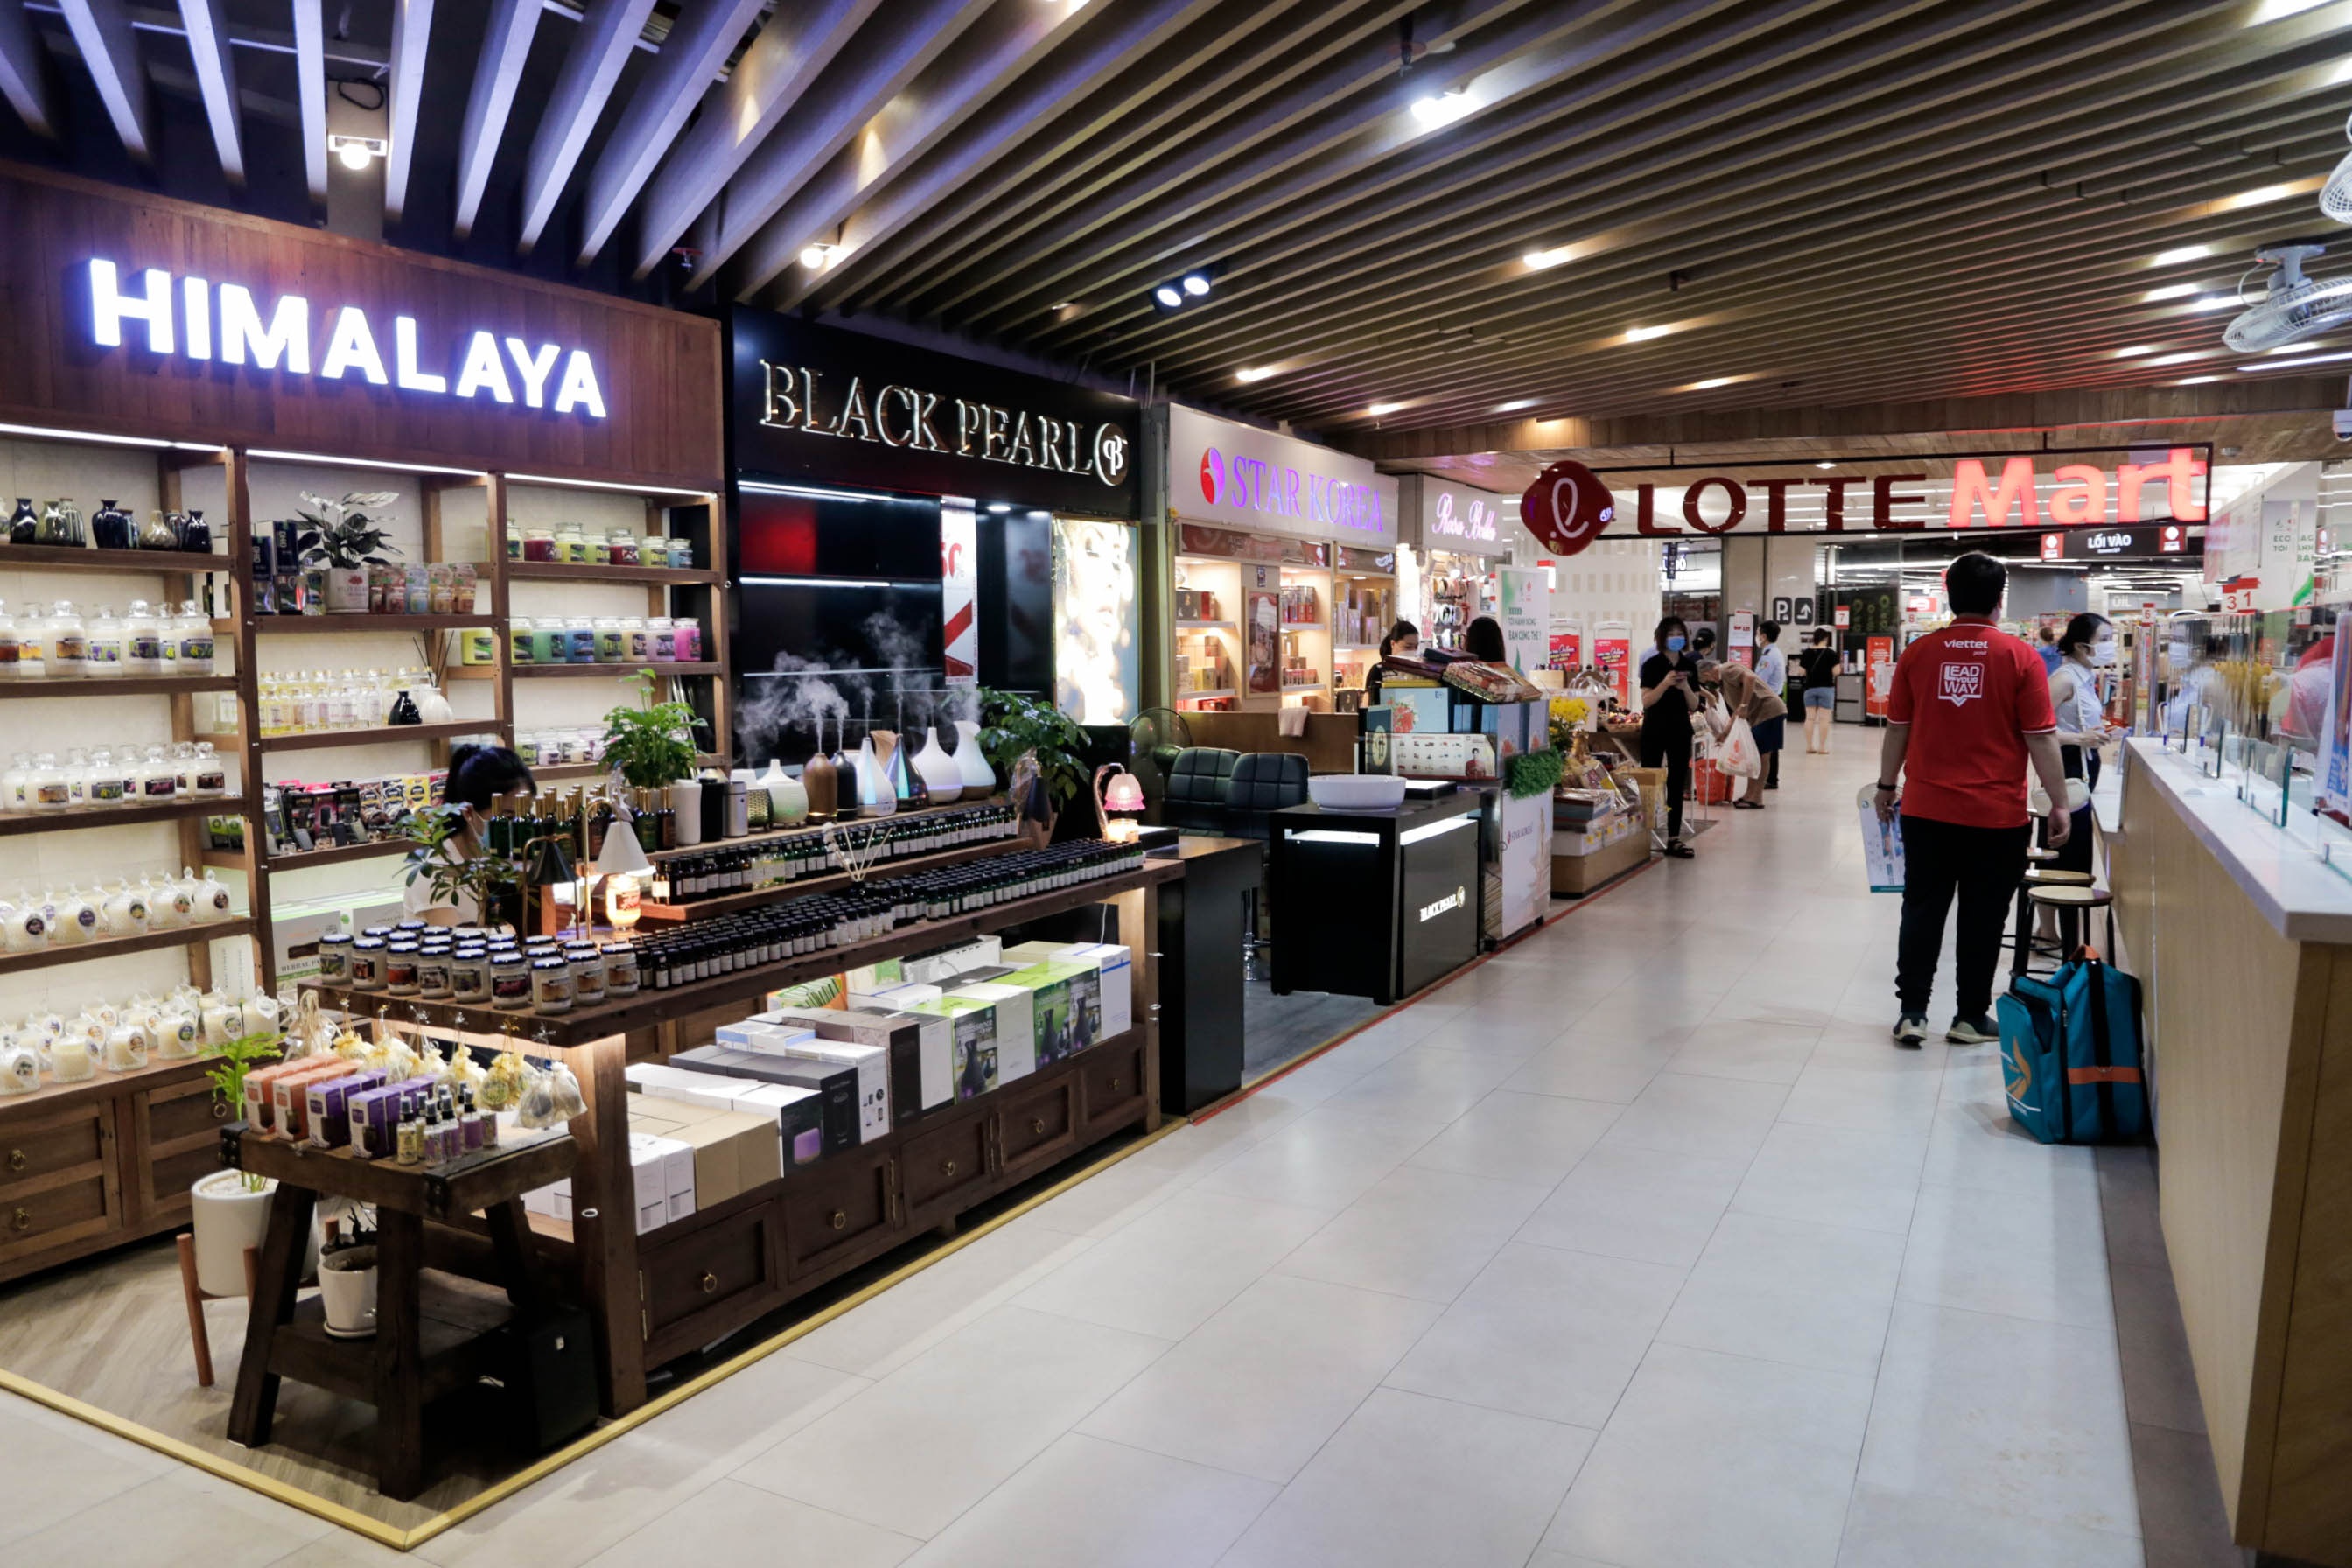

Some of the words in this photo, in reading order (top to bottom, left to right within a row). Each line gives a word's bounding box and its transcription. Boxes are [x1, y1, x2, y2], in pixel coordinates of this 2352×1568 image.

[89, 257, 607, 417] HIMALAYA
[760, 358, 950, 454] BLACK
[955, 399, 1093, 475] PEARL
[1232, 455, 1302, 518] STAR
[1308, 473, 1383, 532] KOREA
[1638, 474, 1926, 534] LOTTE
[1949, 447, 2207, 528] Mart
[2107, 533, 2132, 547] VÀO
[2112, 595, 2132, 608] OIL
[2227, 596, 2237, 610] 3
[2244, 592, 2250, 607] 1
[1839, 612, 1846, 623] 7
[2144, 609, 2152, 620] 6
[1944, 640, 1988, 648] viettel
[1943, 665, 1980, 681] LEAD
[1944, 681, 1978, 694] WAY
